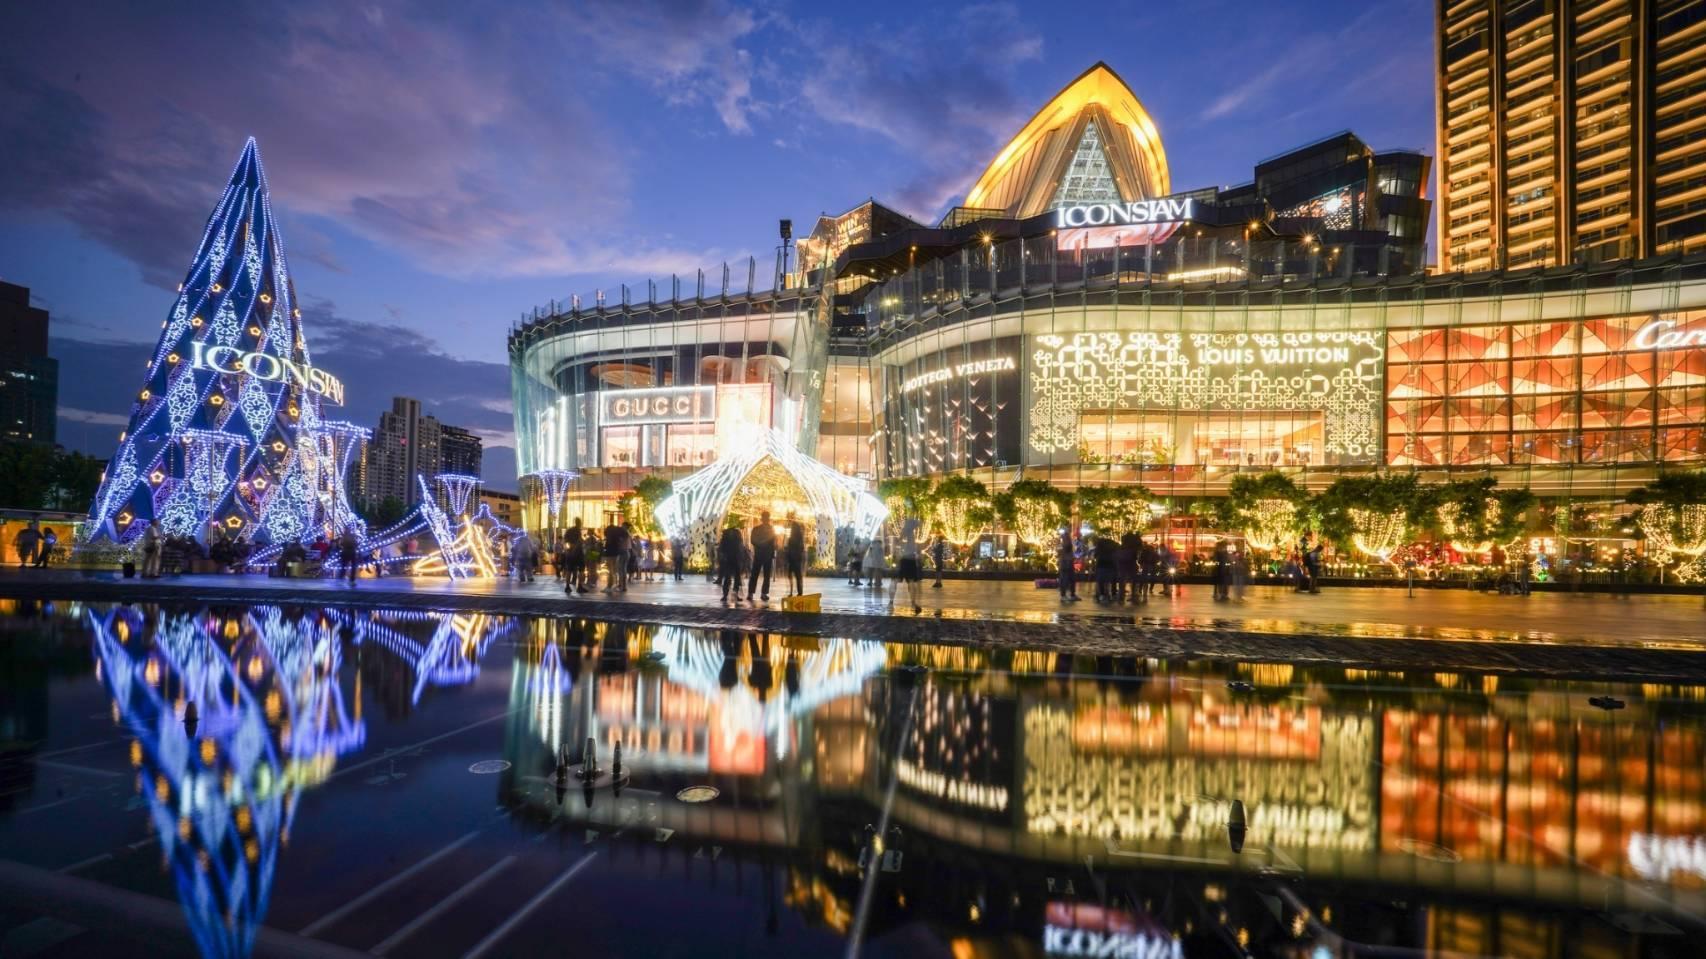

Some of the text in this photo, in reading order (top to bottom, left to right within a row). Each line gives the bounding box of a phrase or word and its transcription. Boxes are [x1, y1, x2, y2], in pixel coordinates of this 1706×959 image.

[1057, 198, 1193, 228] ICONSIAM
[1198, 347, 1350, 365] LOUIS VUITTON
[190, 341, 345, 407] ICONSIAM
[904, 356, 1016, 393] BOTTEGA VENETA
